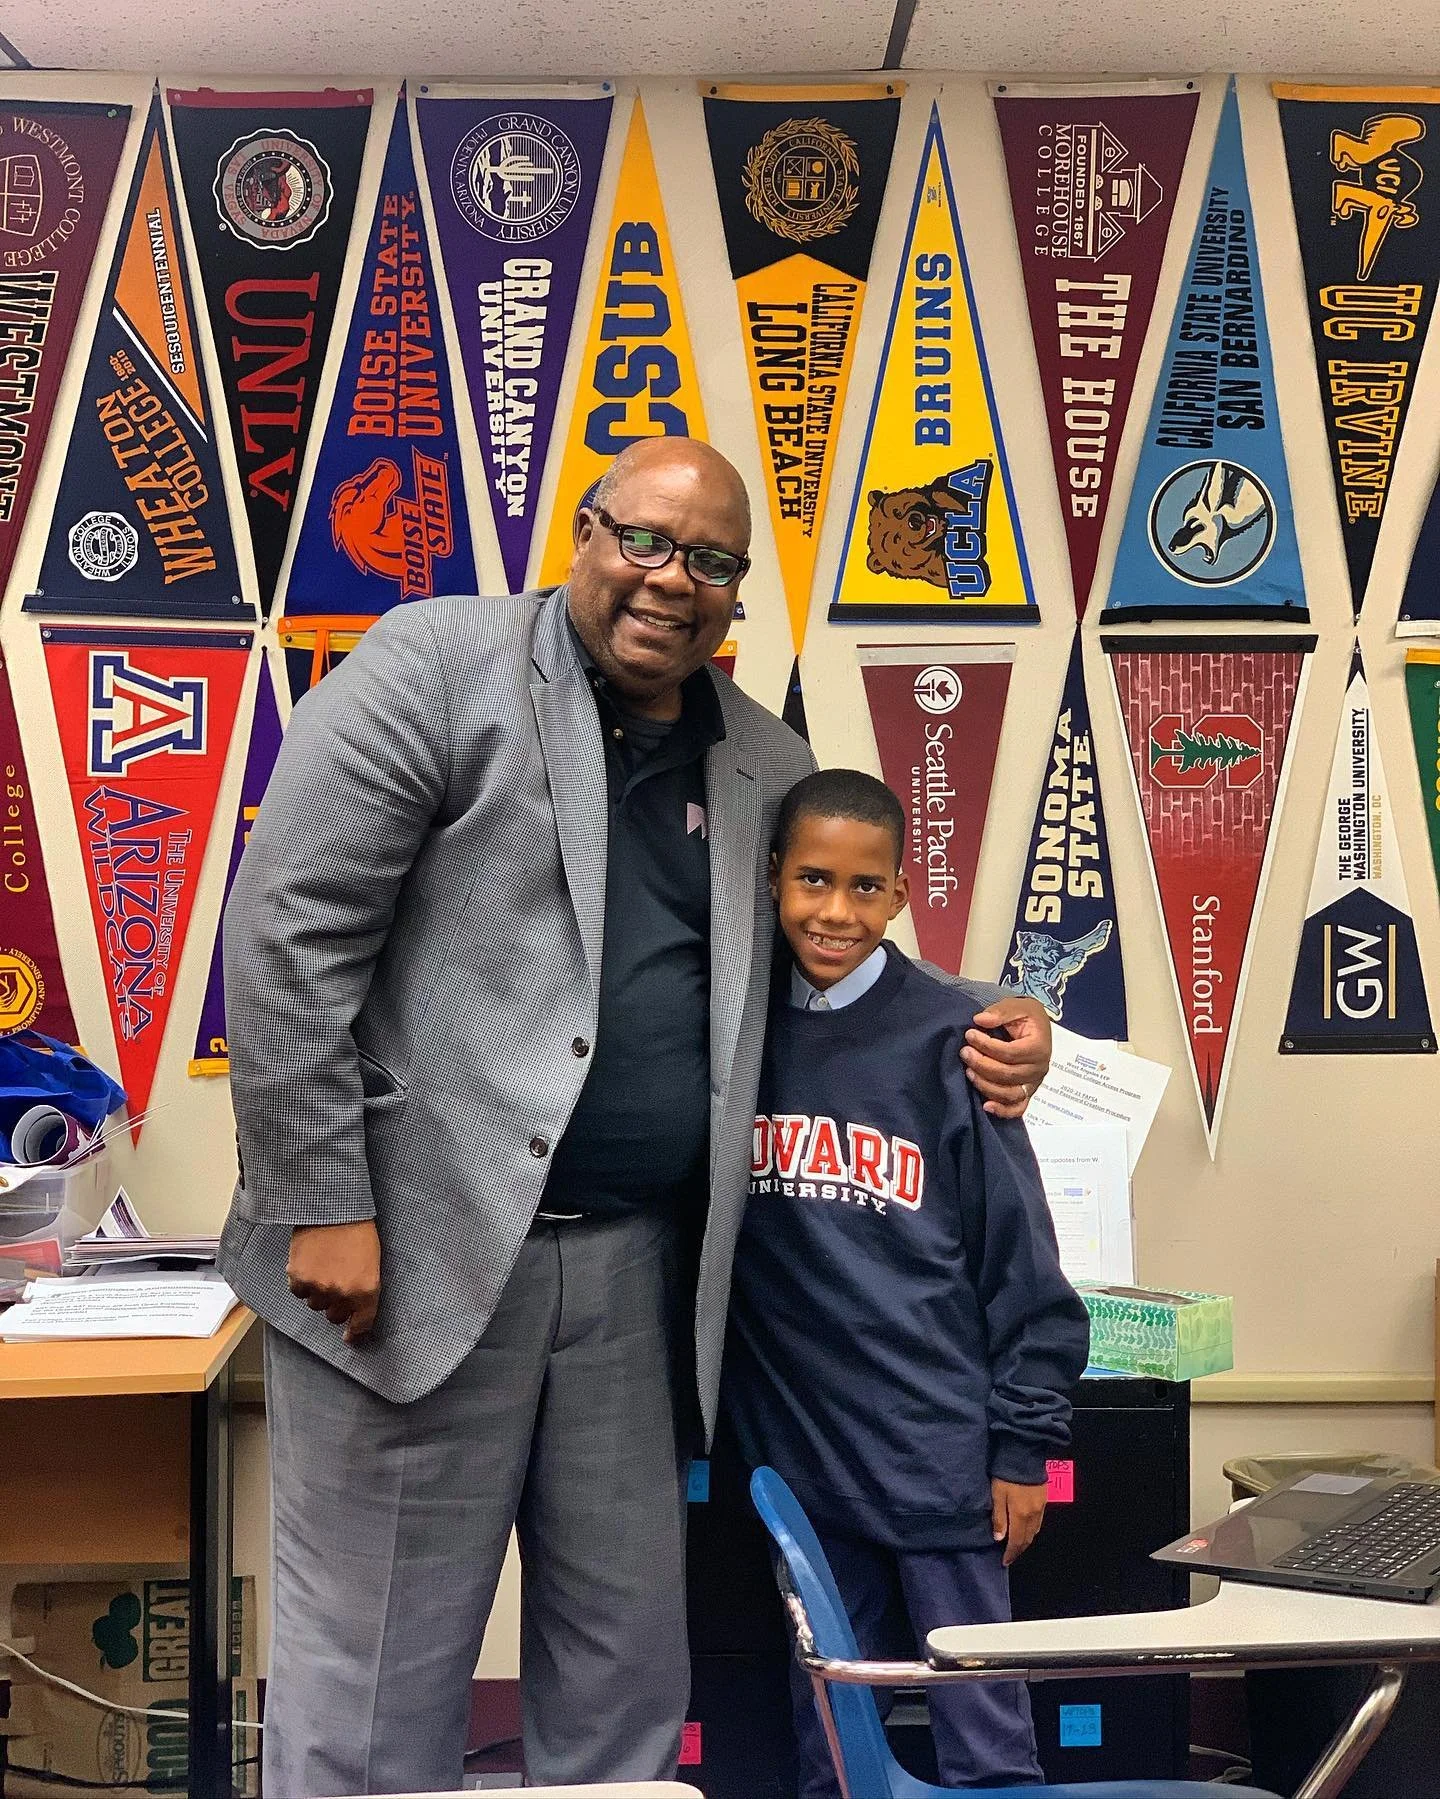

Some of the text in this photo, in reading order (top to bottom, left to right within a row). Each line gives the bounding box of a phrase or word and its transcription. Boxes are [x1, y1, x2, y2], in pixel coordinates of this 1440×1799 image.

[4, 117, 85, 267] WESTMONT COLLEGE
[261, 215, 312, 239] NEVADA
[456, 181, 486, 228] ARIZONA
[495, 117, 579, 240] GRAND CANYON UNIVERSITY
[764, 149, 782, 206] LONG BEACH
[785, 138, 845, 221] CALIFORNIA STATE UNIVERSITY
[1034, 124, 1053, 257] COLLEGE
[1051, 123, 1072, 259] MOREHOUSE
[1073, 134, 1087, 248] FOUNDED 1867
[1375, 158, 1401, 194] UCI
[145, 207, 186, 375] SESQUICENTENNIAL
[349, 194, 402, 438] BOISE STATE
[397, 197, 444, 438] UNIVERSITY
[583, 222, 689, 456] CSUB
[914, 252, 952, 446] BRUINS
[1156, 186, 1230, 450] CALIFORNIA STATE UNIVERSITY
[1216, 209, 1266, 432] SAN BERNARDINO
[116, 350, 136, 375] 2010
[224, 271, 320, 512] UNLV
[477, 281, 509, 500] UNIVERSITY
[503, 257, 553, 517] GRAND CANYON
[747, 301, 806, 521] LONG BEACH
[801, 283, 857, 538] CALIFORNIA STATE UNIVERSITY
[1055, 274, 1132, 519] THE HOUSE
[1319, 284, 1423, 518] UC IRVINE
[96, 392, 217, 584] WHEATON
[116, 378, 208, 509] COLLEGE
[420, 462, 447, 551] STATE
[73, 515, 112, 577] WHEATON COLLEGE
[121, 526, 136, 568] ILLINOIS
[401, 504, 427, 589] BOISE
[943, 460, 991, 600] UCLA
[87, 651, 209, 777] A
[4, 764, 30, 893] College
[911, 766, 921, 865] UNIVERSITY
[924, 723, 958, 908] Seattle Pacific
[1025, 708, 1071, 924] SONOMA
[1067, 734, 1104, 899] STATE
[1338, 798, 1351, 880] THE GEORGE
[1352, 793, 1366, 880] WASHINGTON
[1372, 795, 1382, 808] DC
[83, 787, 133, 1040] WILDCATS
[104, 785, 191, 1041] ARIZONA
[154, 829, 192, 998] THE UNIVERSITY OF
[1192, 895, 1223, 1035] Stanford
[1336, 925, 1384, 1020] GW
[9, 948, 45, 1034] PROMPTLY AND SINCERELY
[148, 1583, 190, 1681] GREAT
